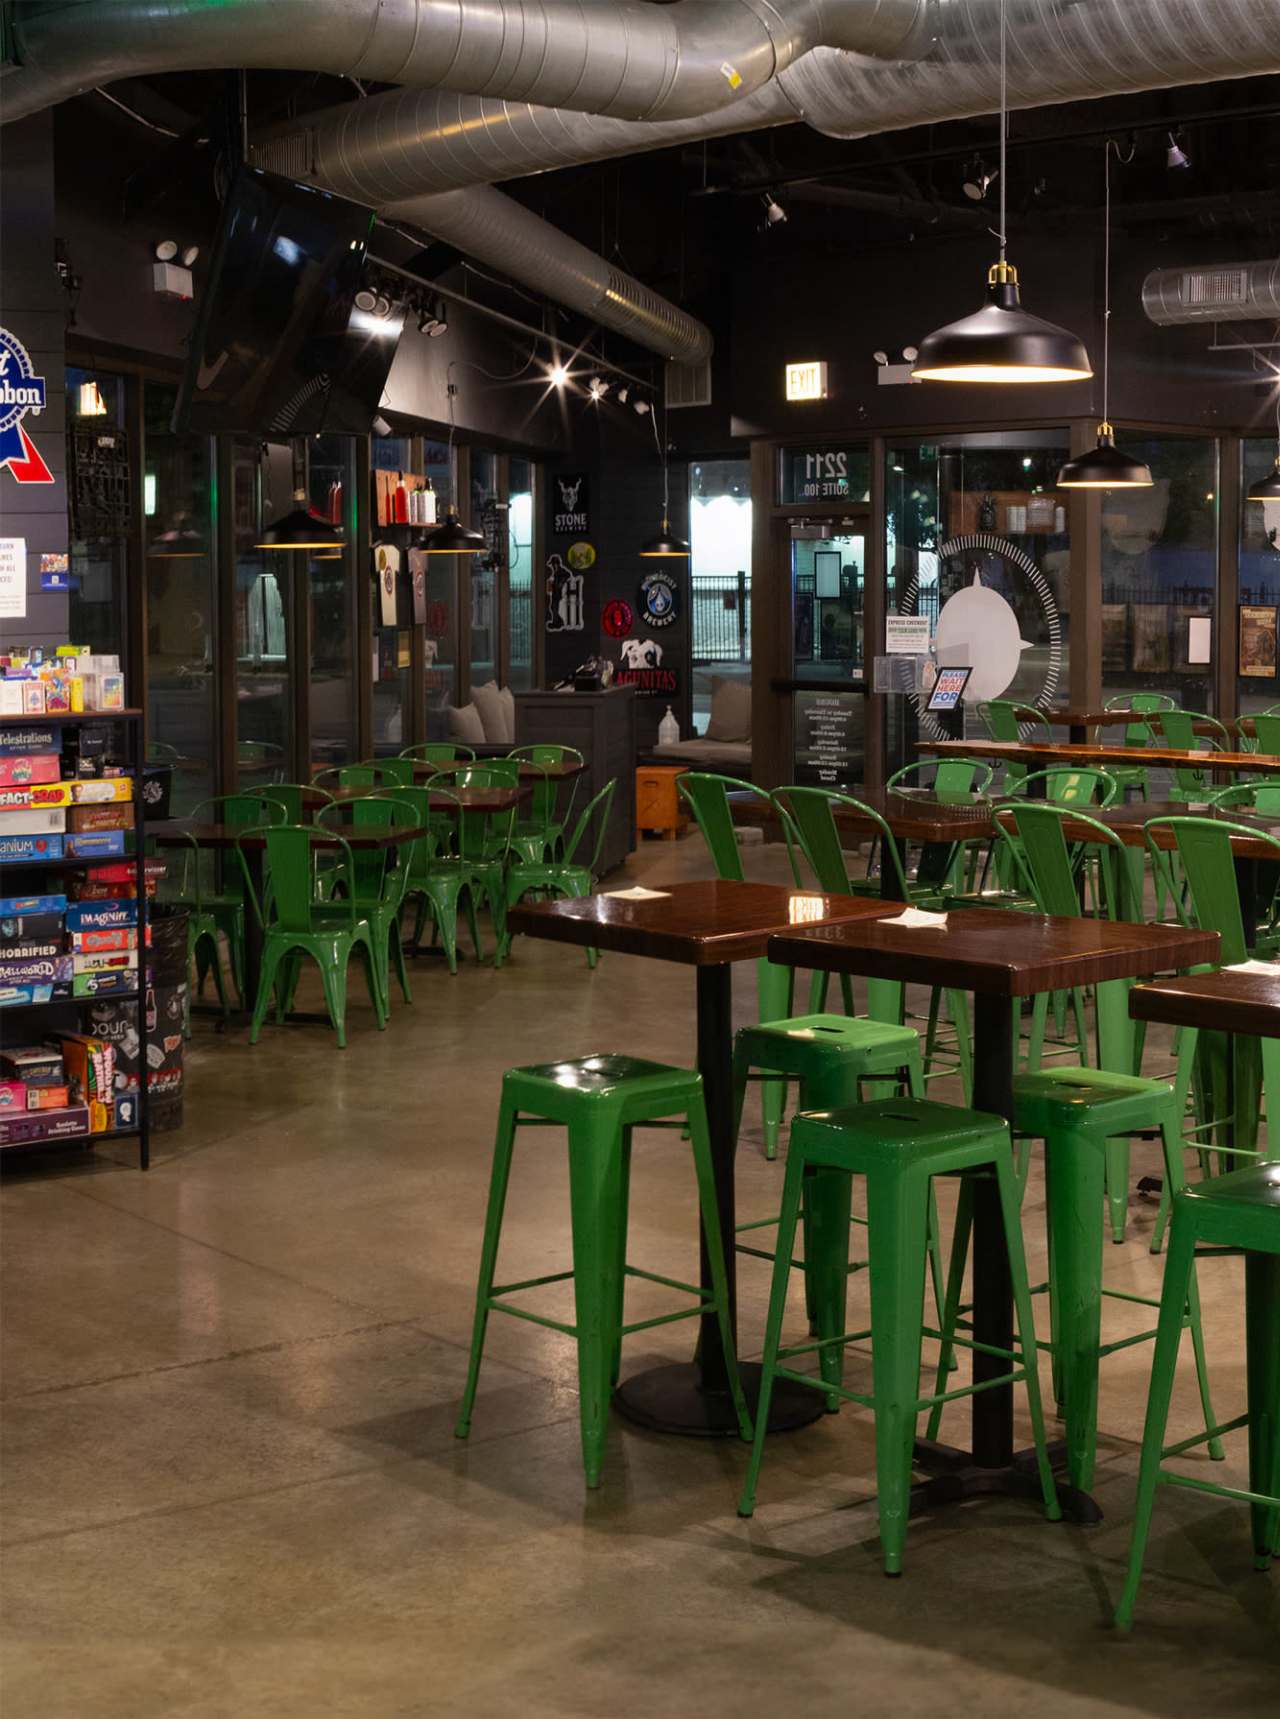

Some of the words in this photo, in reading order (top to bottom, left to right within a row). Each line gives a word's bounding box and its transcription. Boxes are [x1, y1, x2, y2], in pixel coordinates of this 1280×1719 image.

[791, 368, 816, 395] EXIT
[554, 513, 587, 527] STONE
[934, 692, 958, 701] FOR
